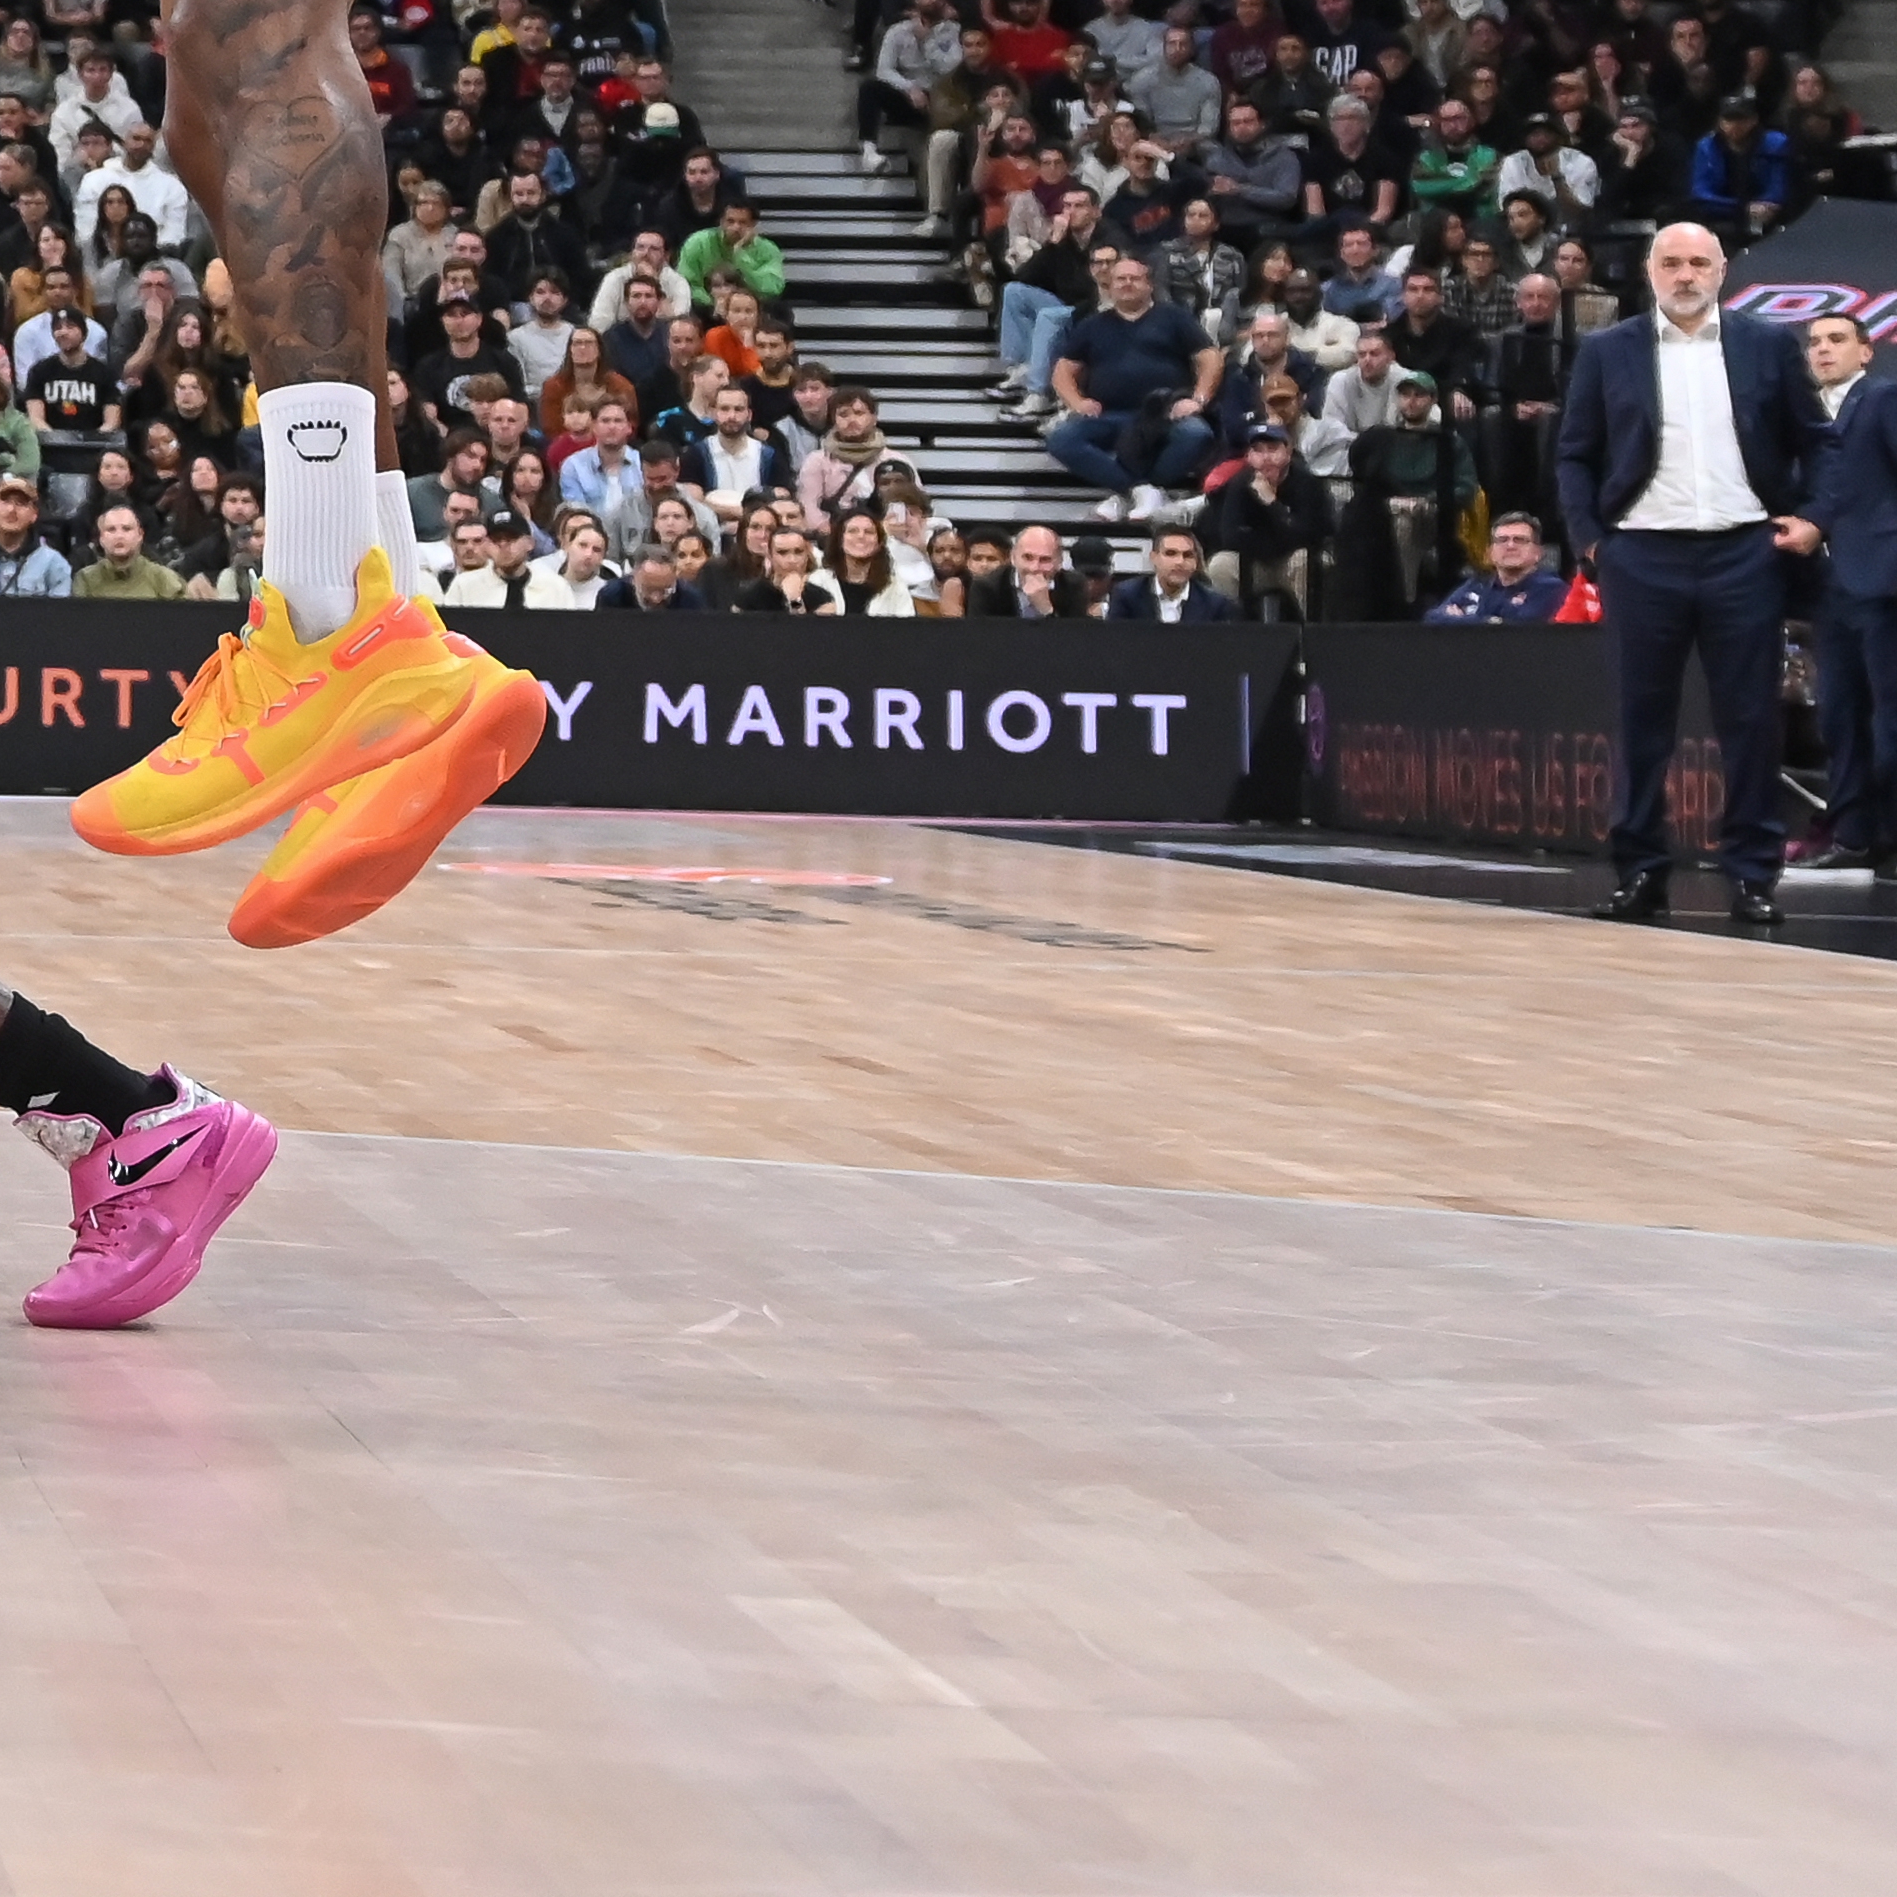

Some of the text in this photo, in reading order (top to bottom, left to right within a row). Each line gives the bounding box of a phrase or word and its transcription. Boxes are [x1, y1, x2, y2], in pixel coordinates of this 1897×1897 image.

[1313, 43, 1359, 87] GAP
[43, 378, 97, 406] UTAH
[641, 681, 1188, 756] MARRIOTT
